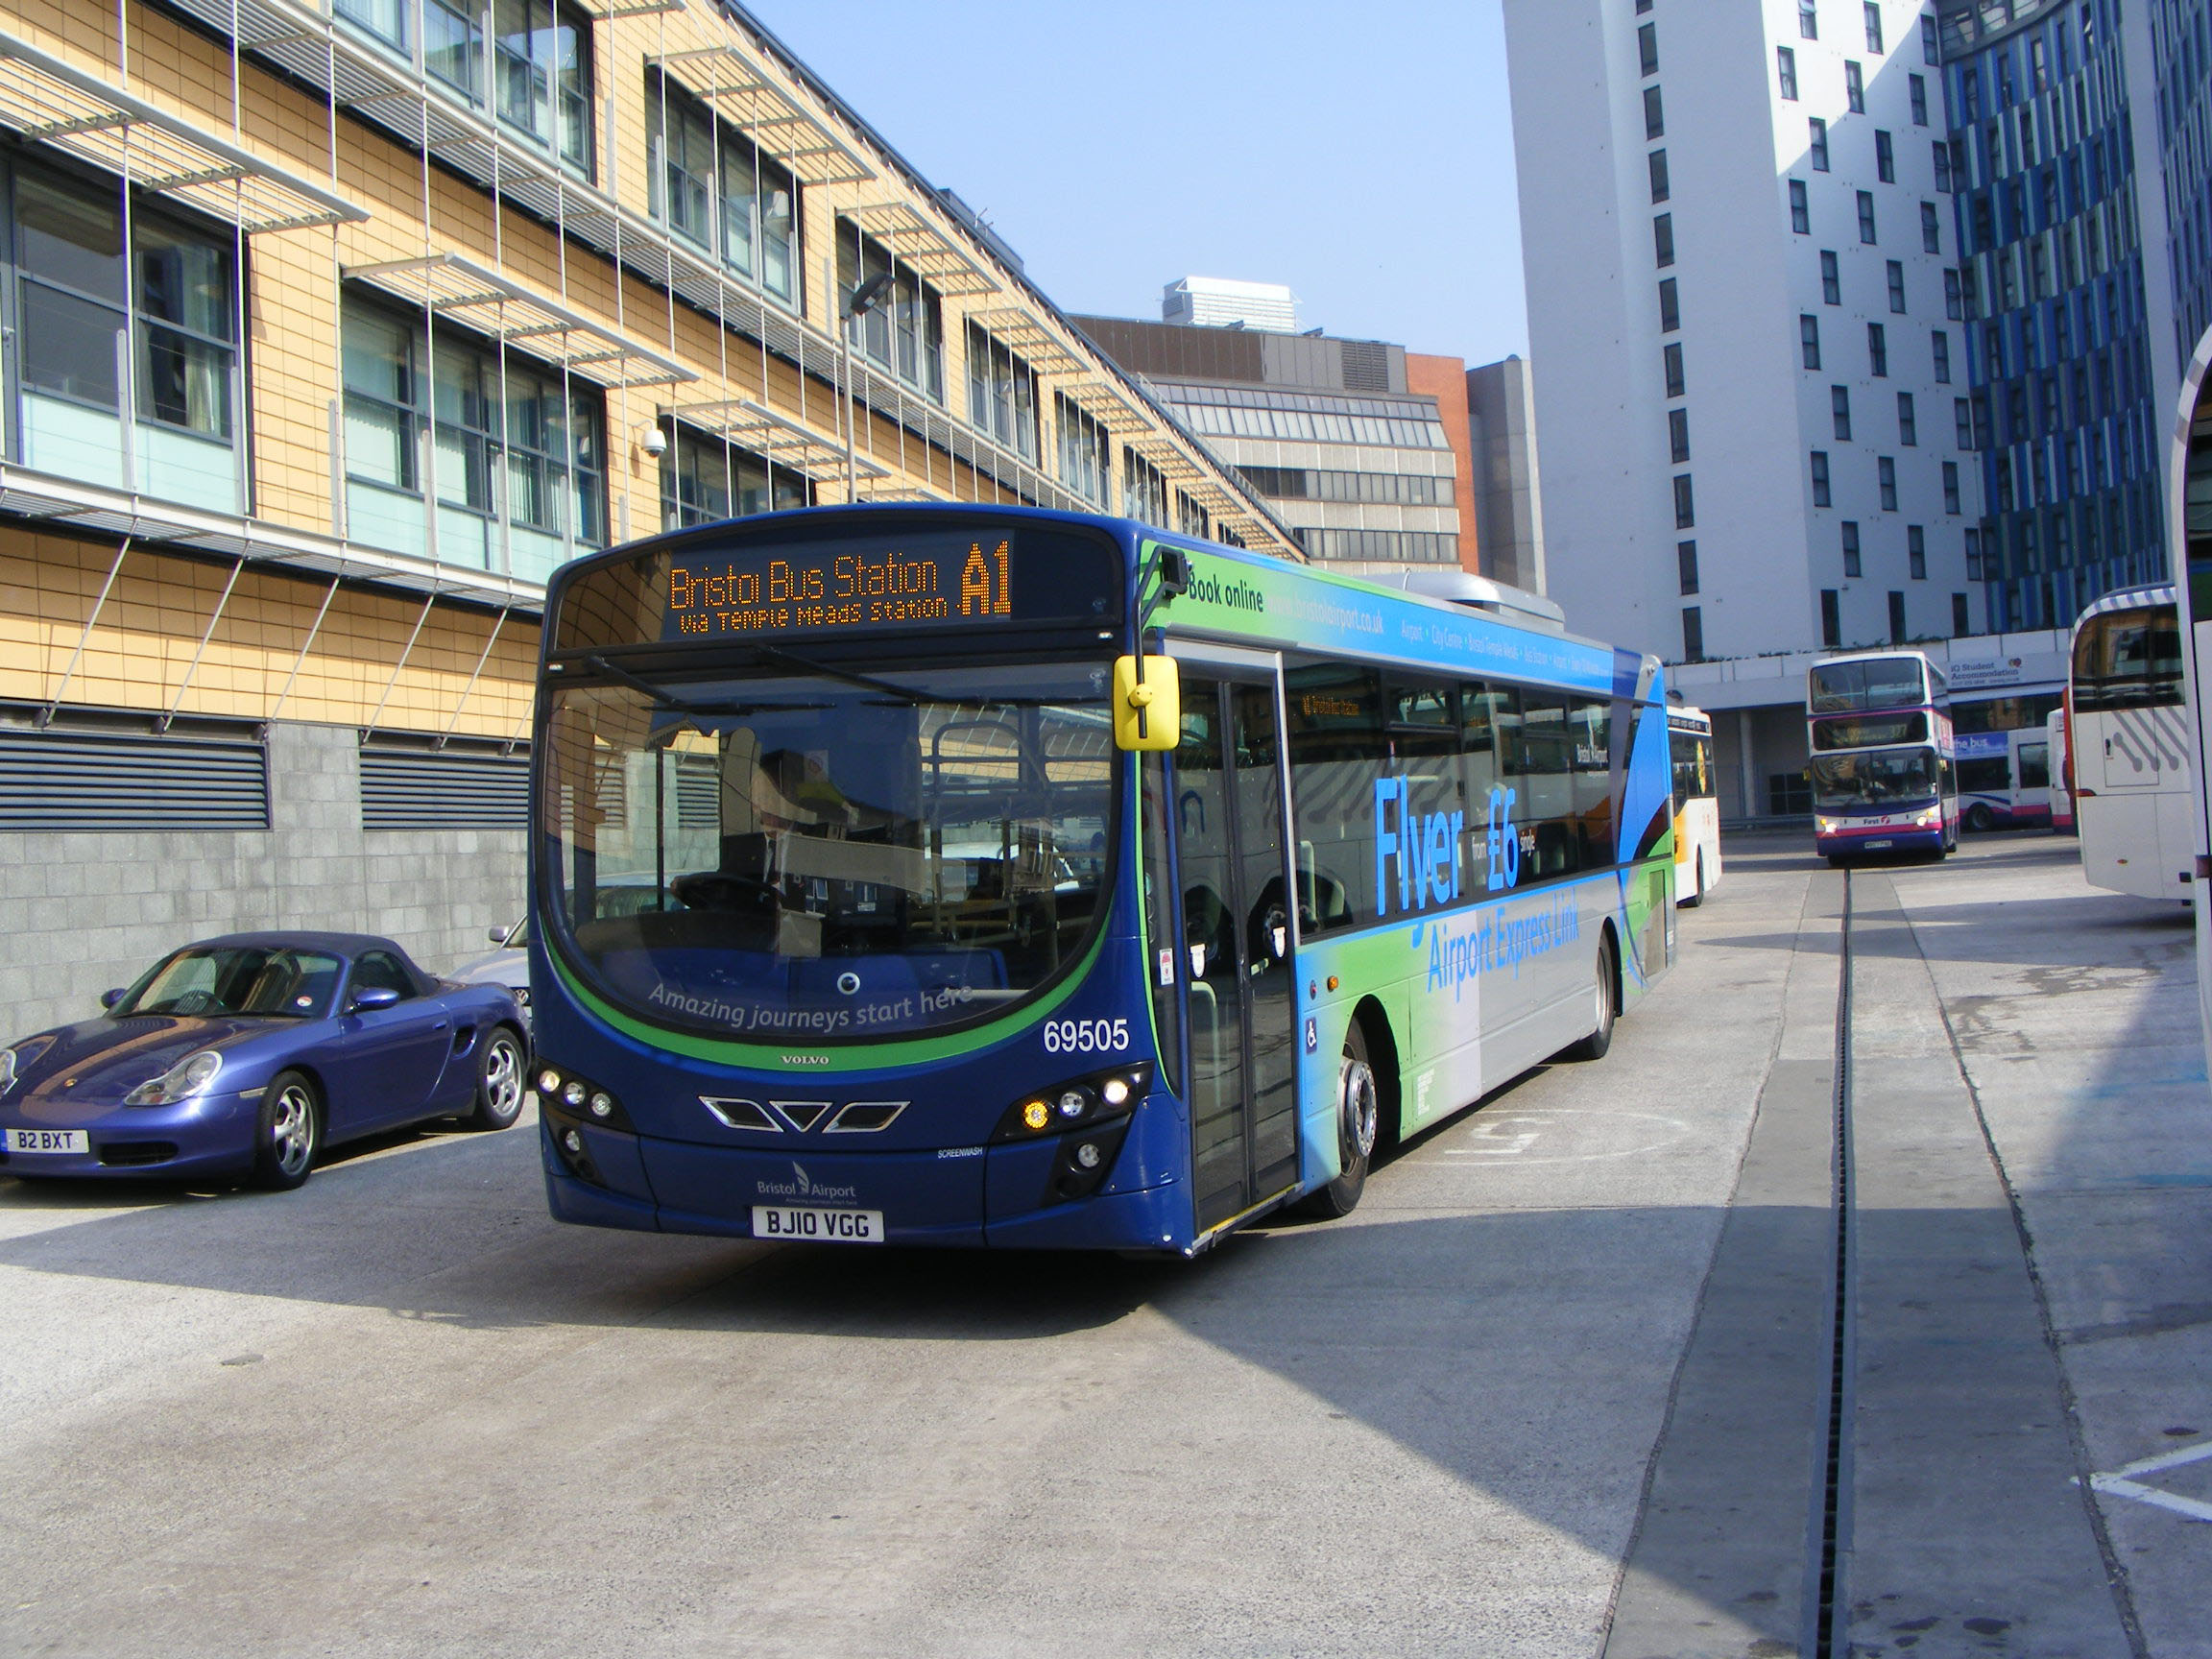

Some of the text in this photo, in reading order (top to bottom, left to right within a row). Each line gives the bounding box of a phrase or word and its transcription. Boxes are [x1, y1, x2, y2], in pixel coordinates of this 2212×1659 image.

[671, 552, 937, 609] Bristol Bus Station
[961, 541, 1011, 616] A1
[1189, 572, 1383, 636] Book online www.bristolairport.co.uk
[1951, 669, 2019, 680] Accommodation
[1961, 662, 1994, 671] Student
[1472, 788, 1535, 891] from £6 single
[1376, 773, 1463, 949] Flyer
[1428, 887, 1579, 1003] Airport Express Link
[648, 983, 974, 1033] Amazing journeys start here
[1044, 1019, 1129, 1052] 69505
[781, 1055, 830, 1065] VOLVO
[17, 1132, 73, 1149] B2 BXT
[937, 1146, 983, 1159] SCREENWASH
[757, 1181, 856, 1199] Bristol Airport
[766, 1211, 869, 1238] BJ10 VGG
